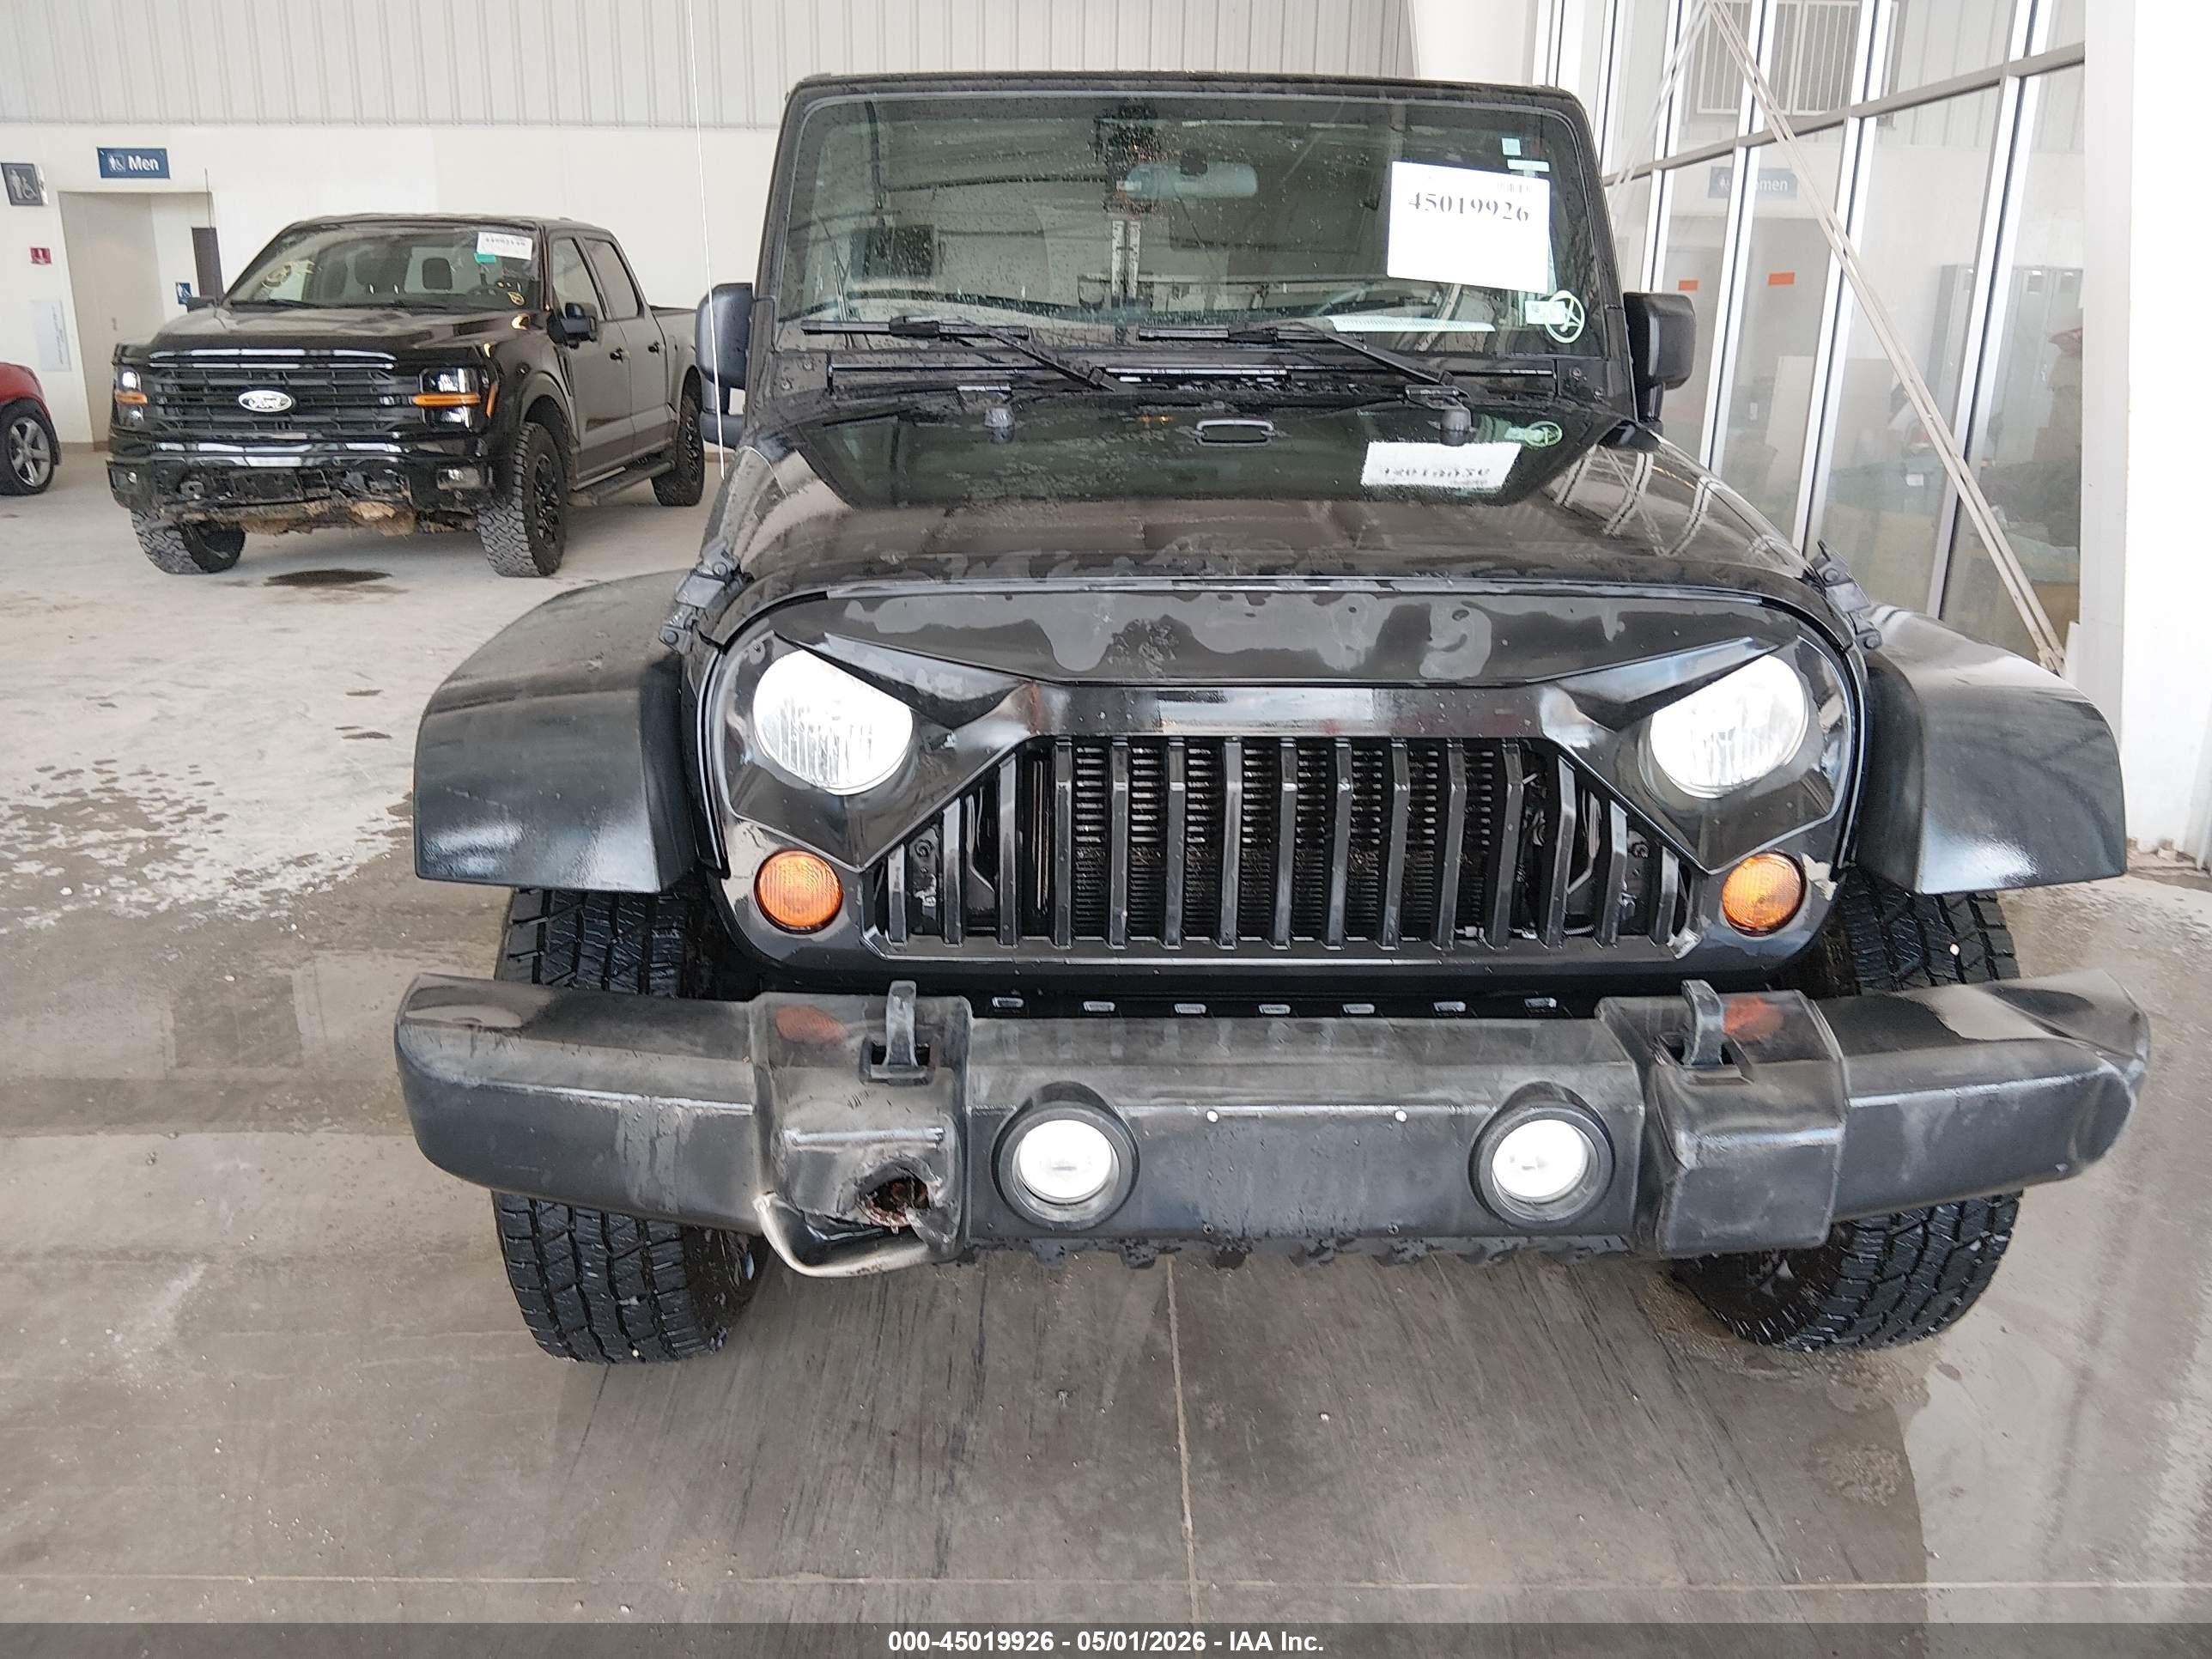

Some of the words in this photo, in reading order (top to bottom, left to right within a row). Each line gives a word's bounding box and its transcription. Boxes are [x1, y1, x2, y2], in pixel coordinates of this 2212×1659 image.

[127, 155, 160, 172] Men
[1756, 178, 1789, 192] men
[1408, 191, 1529, 222] 45019926
